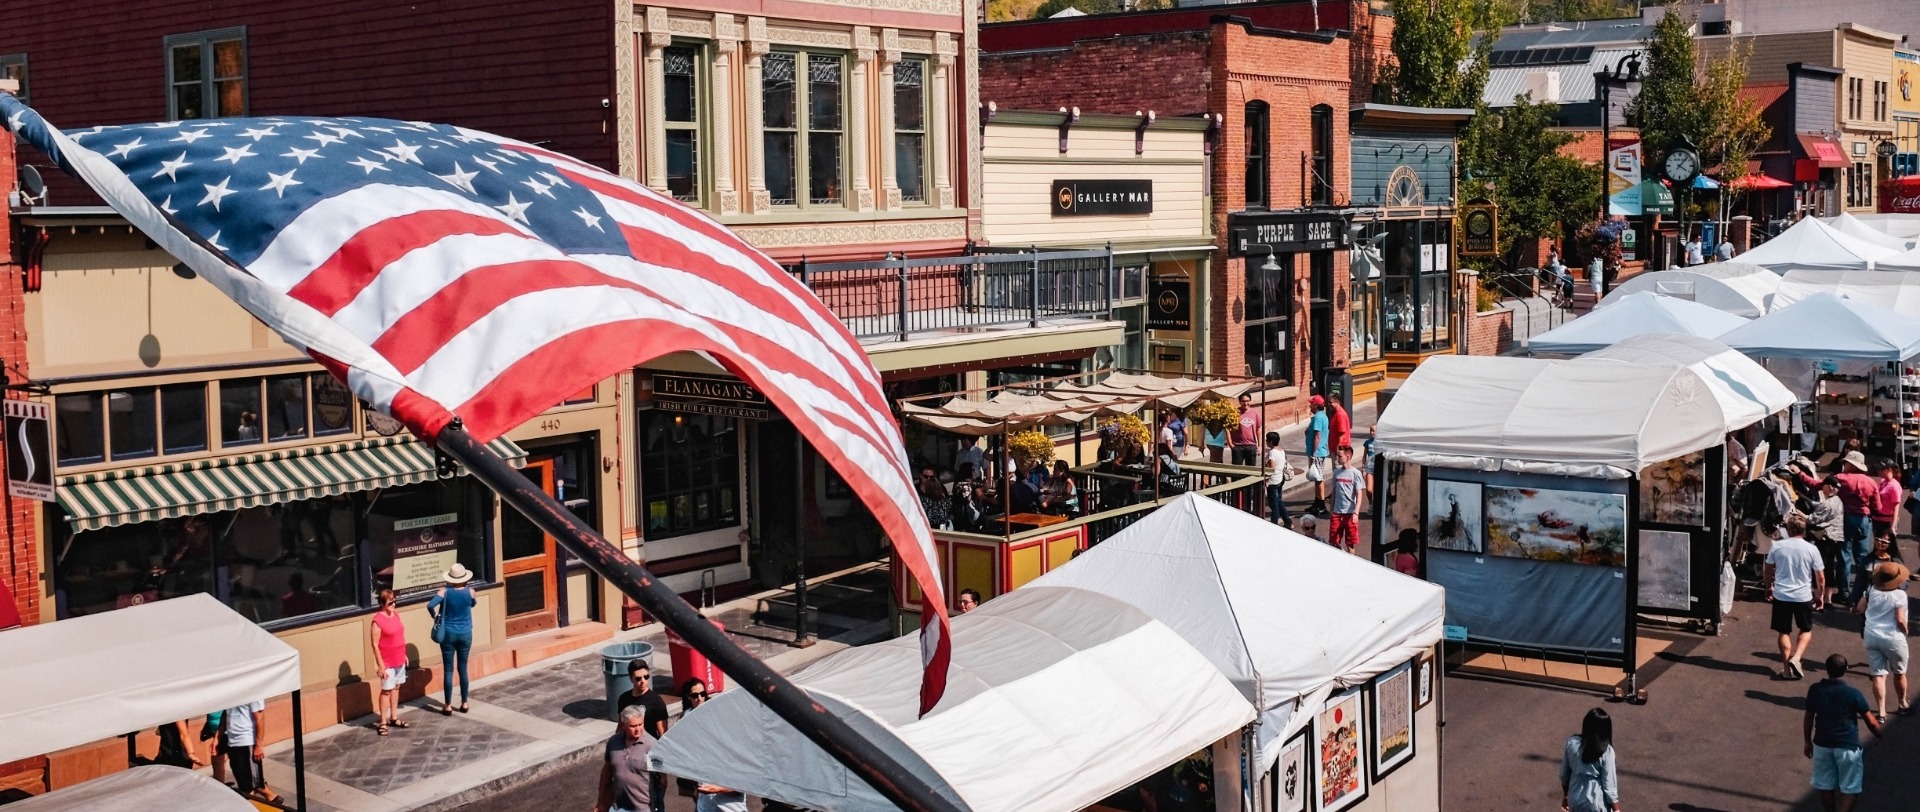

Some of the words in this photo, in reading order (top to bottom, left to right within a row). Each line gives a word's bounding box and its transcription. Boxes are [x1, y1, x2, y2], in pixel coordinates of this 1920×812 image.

[1078, 193, 1125, 203] GALLERY
[1129, 192, 1149, 203] MAR
[1257, 224, 1294, 243] PURPLE
[1308, 222, 1331, 240] SAGE
[665, 379, 753, 399] FLANAGAN'S
[660, 401, 680, 410] IRISH
[683, 404, 698, 412] PUB
[708, 406, 761, 418] RESTAURANT
[541, 419, 560, 431] 440
[414, 518, 428, 526] SALE
[434, 515, 452, 524] LEASE
[397, 544, 428, 553] BERKSHIRE
[428, 540, 455, 549] HATHAWAY
